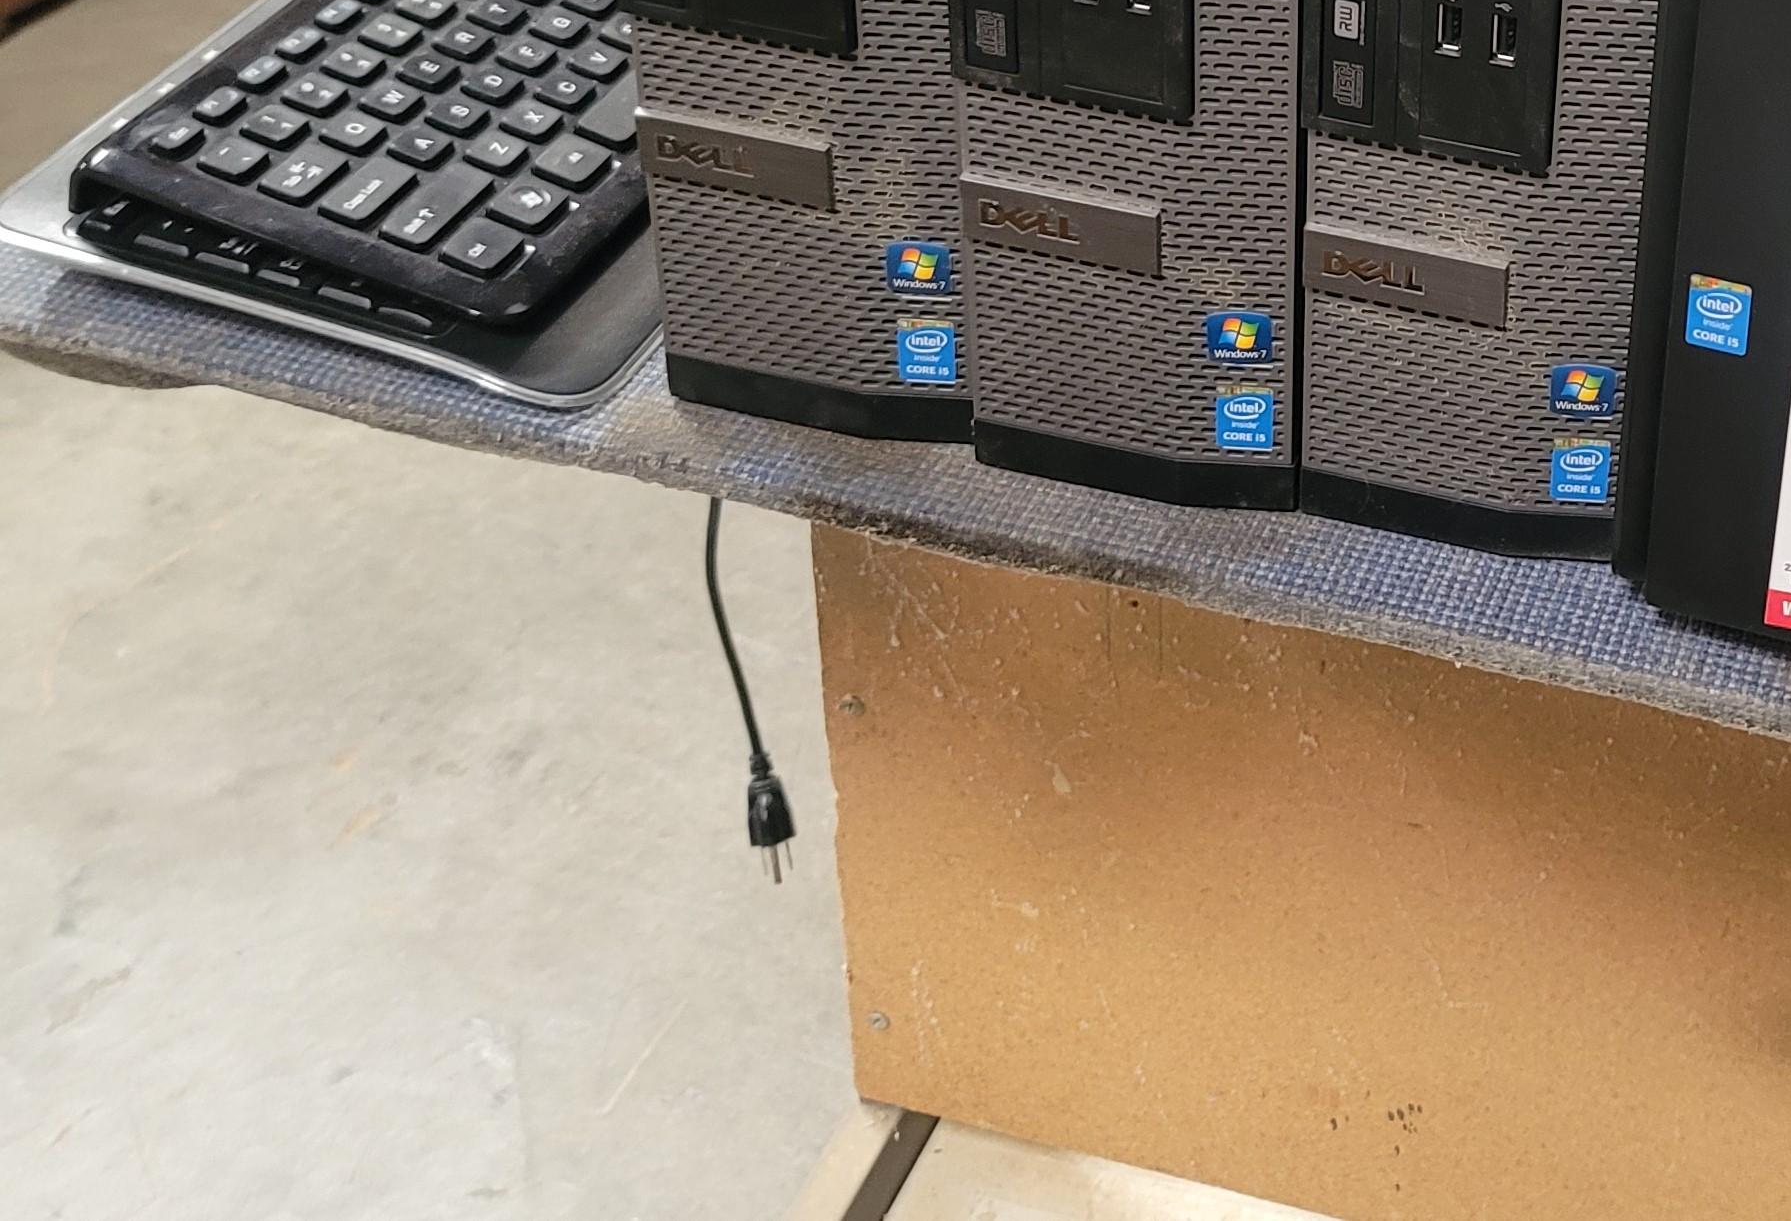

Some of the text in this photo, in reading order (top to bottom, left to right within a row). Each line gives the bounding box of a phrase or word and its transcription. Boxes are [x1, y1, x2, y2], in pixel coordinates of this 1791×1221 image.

[1338, 5, 1353, 33] RW
[655, 133, 755, 178] DELL
[978, 198, 1080, 245] DELL
[1320, 249, 1425, 296] DELL
[893, 277, 946, 290] Windows 7
[1702, 295, 1735, 314] intel
[911, 334, 942, 347] intel
[1692, 328, 1726, 346] CORE
[1214, 348, 1267, 360] Windows 7
[906, 364, 937, 376] CORE
[1229, 401, 1260, 414] intel
[1555, 400, 1608, 412] Windows 7
[1222, 431, 1253, 443] CORE
[1566, 453, 1597, 466] intel
[1557, 484, 1588, 494] CORE
